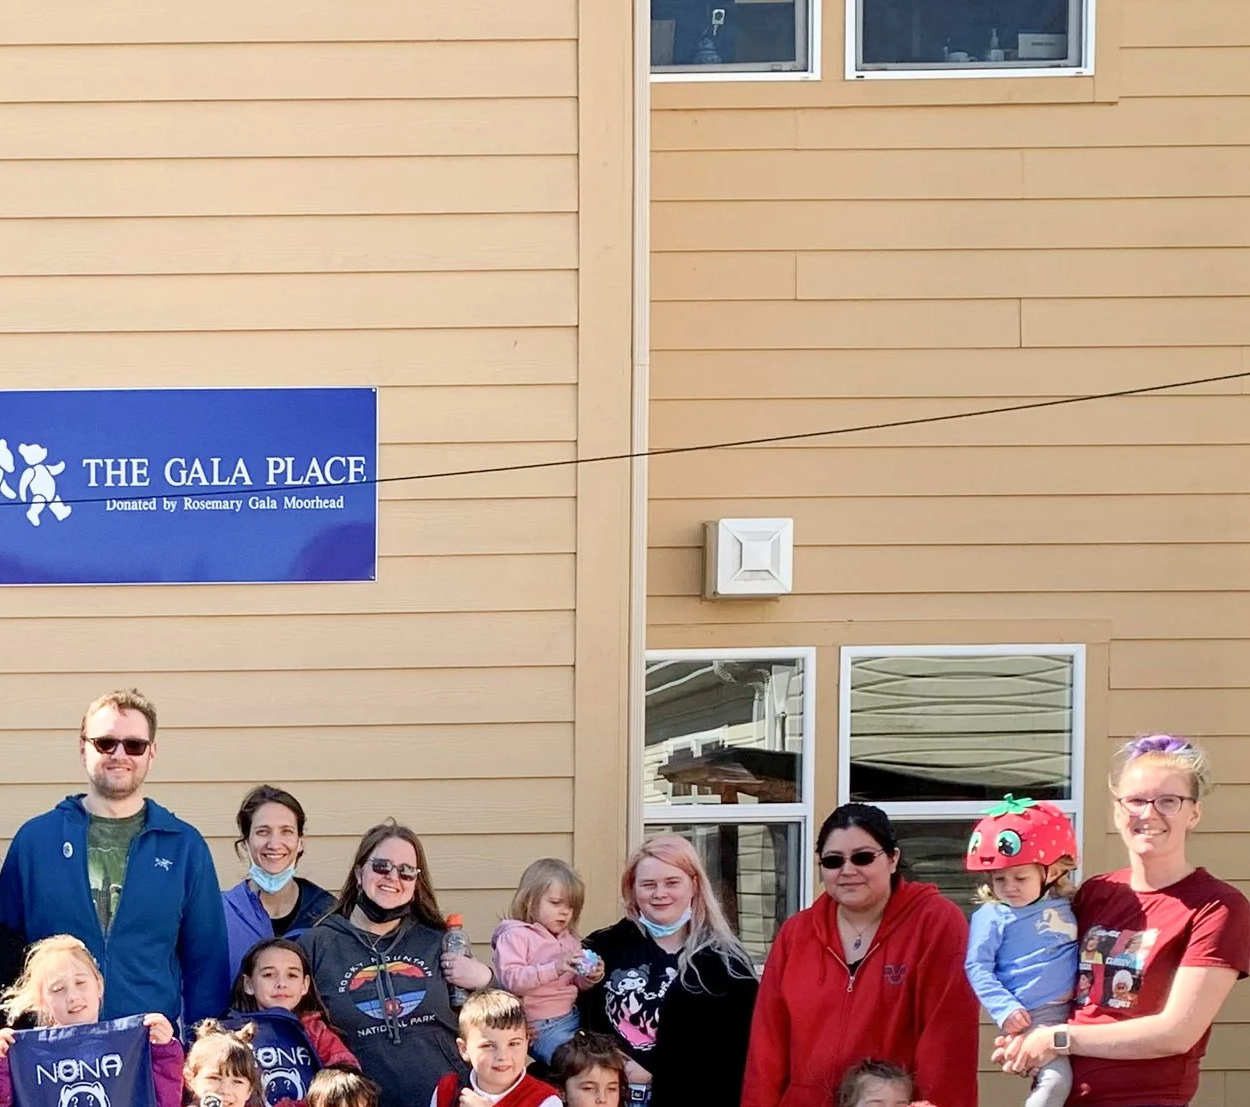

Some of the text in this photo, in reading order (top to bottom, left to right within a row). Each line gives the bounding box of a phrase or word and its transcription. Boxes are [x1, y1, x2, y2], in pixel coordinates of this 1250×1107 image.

[82, 456, 367, 487] THE GALA PLACE
[105, 495, 344, 512] Donated by Rosemary Gala Moorhead
[338, 962, 364, 993] ROCKY
[410, 1014, 436, 1026] PARK
[36, 1053, 123, 1085] NONA
[252, 1046, 311, 1068] ONA
